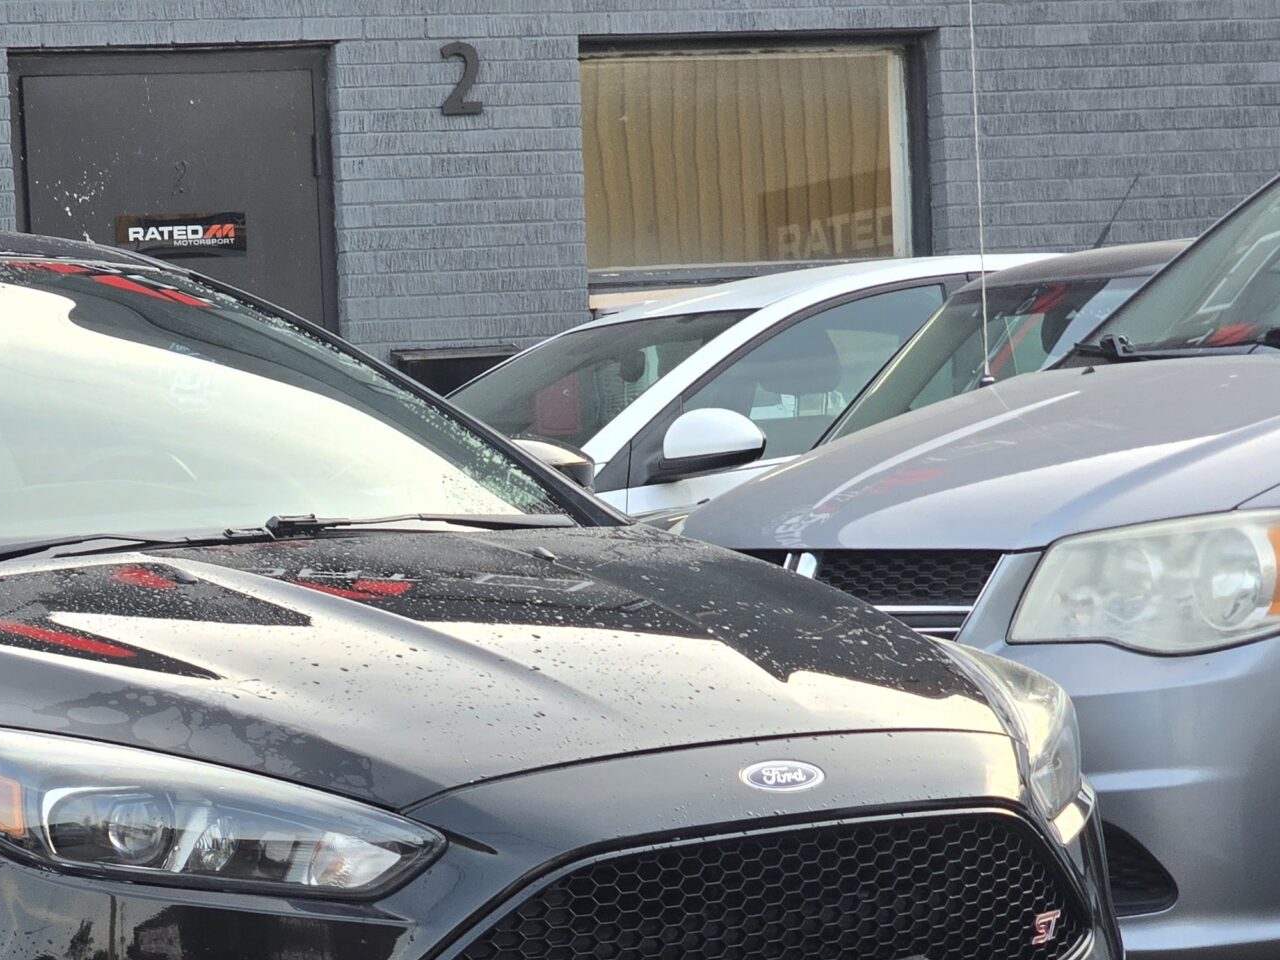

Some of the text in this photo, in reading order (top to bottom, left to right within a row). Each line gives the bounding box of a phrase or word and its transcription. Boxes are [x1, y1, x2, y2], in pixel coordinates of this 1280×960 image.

[440, 41, 483, 116] 2
[128, 225, 203, 241] RATED
[173, 238, 235, 247] MOTORSPORT
[761, 766, 807, 785] Ford
[1032, 909, 1061, 945] ST
